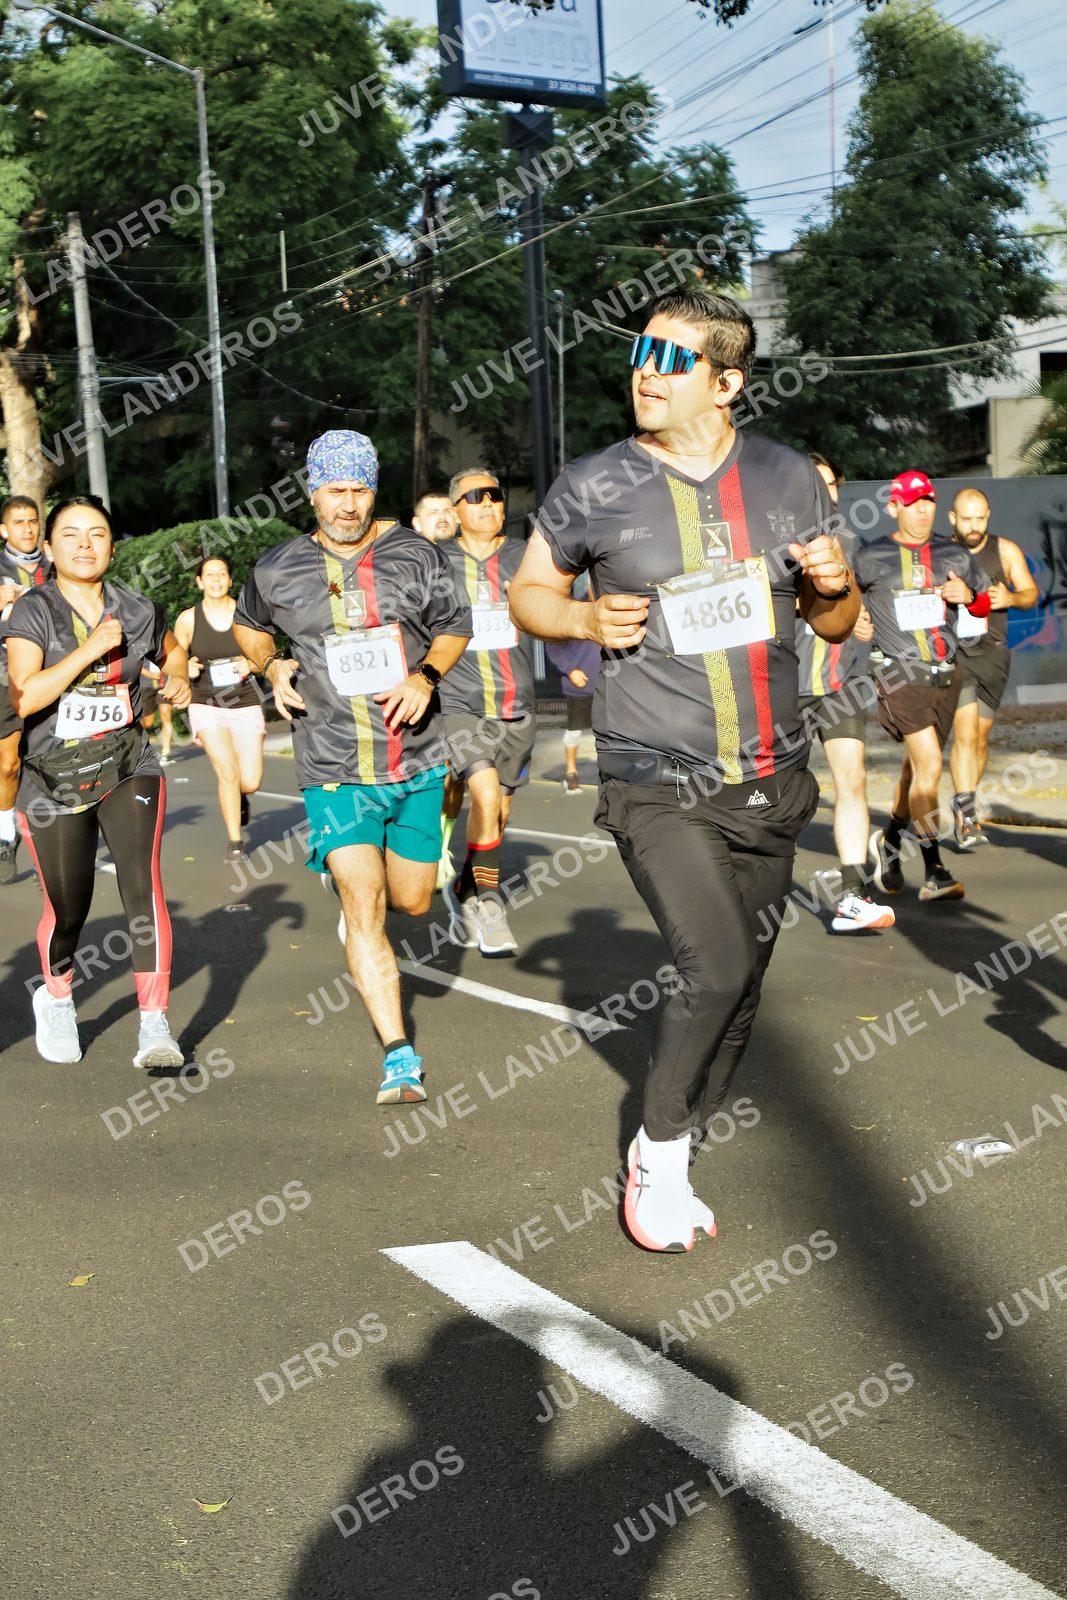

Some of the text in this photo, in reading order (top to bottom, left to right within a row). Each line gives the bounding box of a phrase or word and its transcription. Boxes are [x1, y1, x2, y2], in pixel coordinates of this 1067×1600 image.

[682, 590, 753, 632] 4866
[339, 647, 390, 674] 8821
[64, 702, 124, 722] 13156
